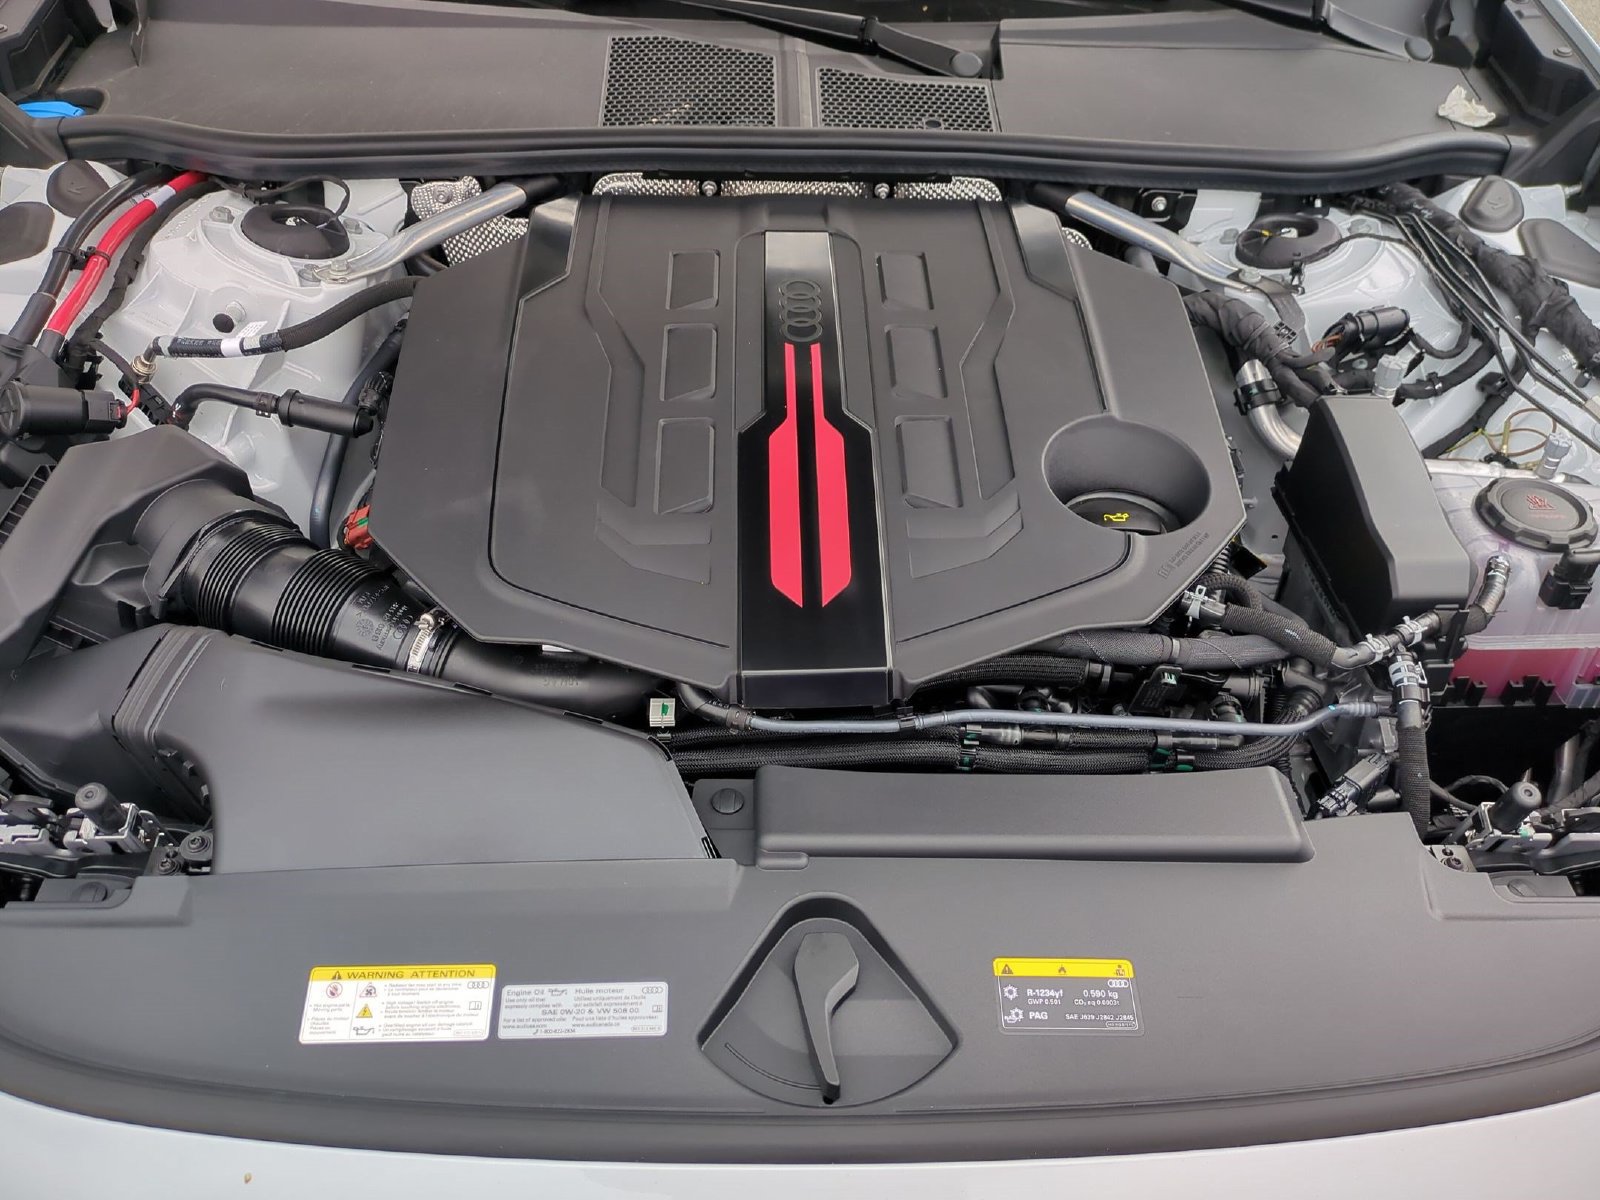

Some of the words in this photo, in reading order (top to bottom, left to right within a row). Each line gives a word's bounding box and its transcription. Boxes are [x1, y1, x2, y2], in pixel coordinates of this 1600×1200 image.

[347, 970, 404, 980] WARNING
[410, 970, 476, 978] ATTENTION
[1026, 989, 1063, 998] R-1234yf
[1082, 990, 1106, 998] 0.590
[1108, 990, 1118, 999] kg
[1029, 1012, 1048, 1020] PAG
